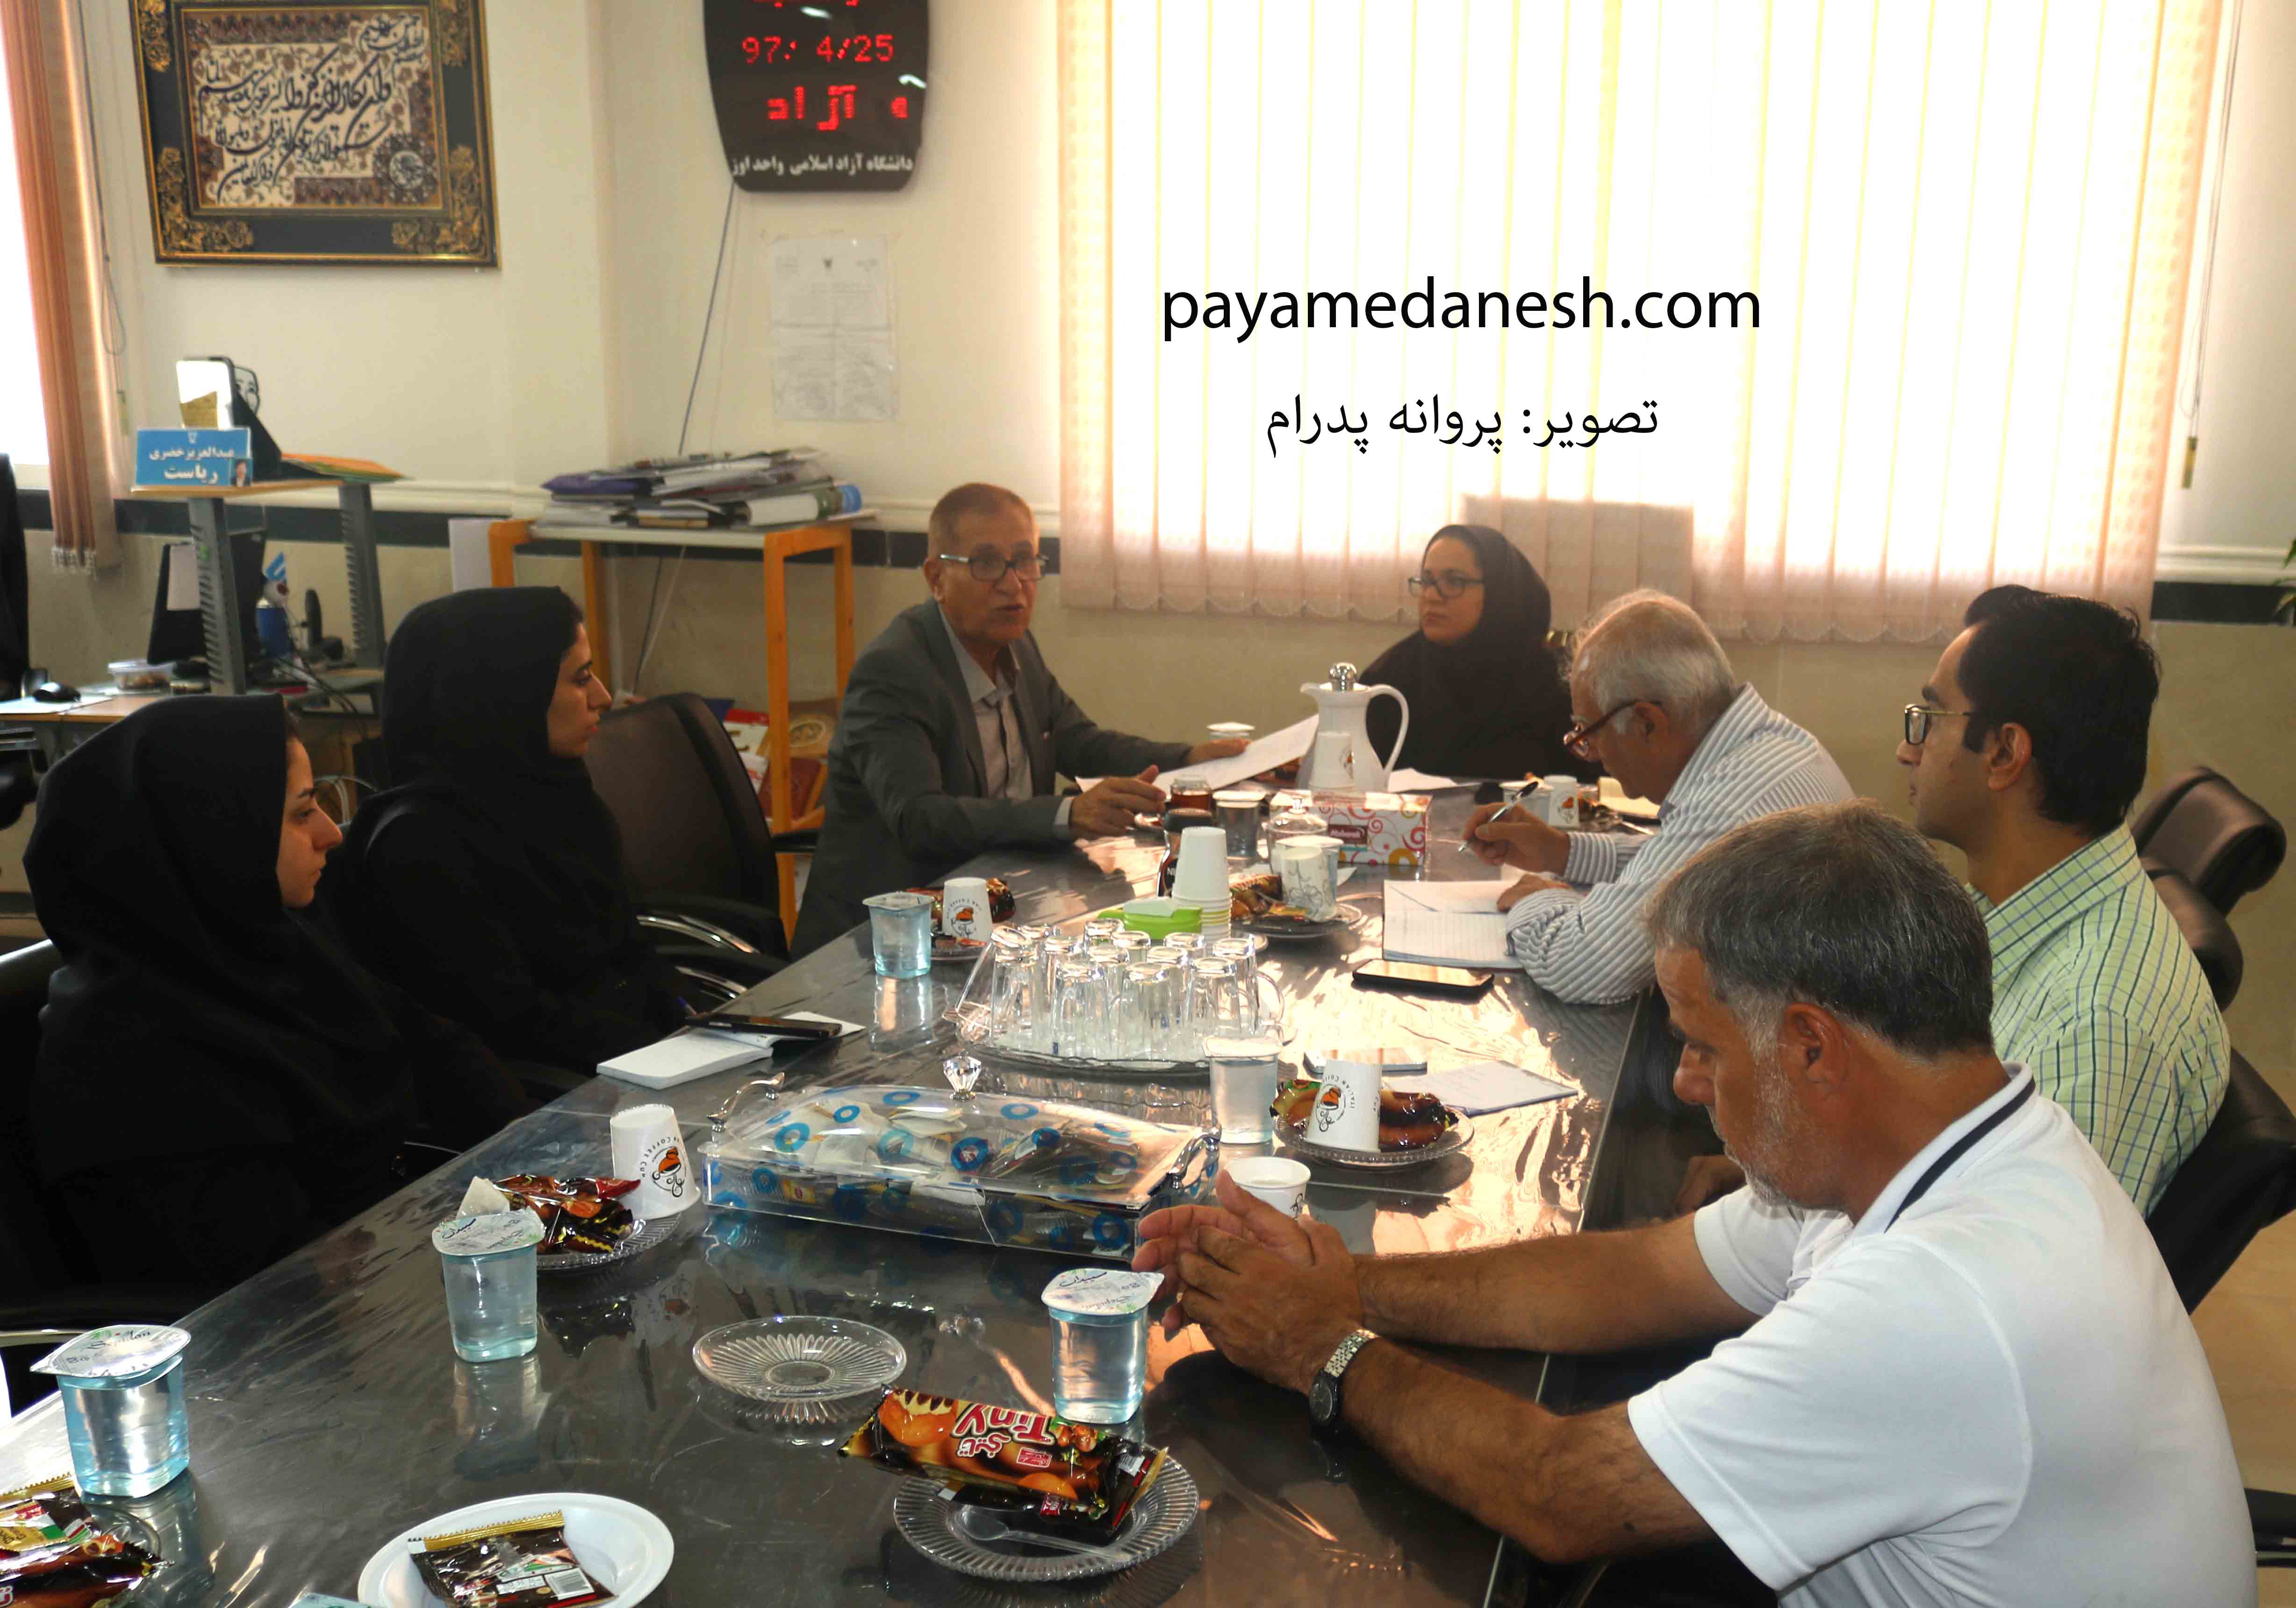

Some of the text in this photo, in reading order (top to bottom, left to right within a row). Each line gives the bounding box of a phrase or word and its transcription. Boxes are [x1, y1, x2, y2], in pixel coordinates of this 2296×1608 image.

[815, 33, 895, 63] 4/25
[752, 154, 785, 176] واحد
[789, 153, 833, 176] اسلامی
[835, 151, 864, 176] آزاد
[866, 155, 913, 171] دانشگاه
[164, 463, 219, 484] ریاست
[951, 1403, 1054, 1446] Tiny
[956, 1433, 1012, 1459] تاینی
